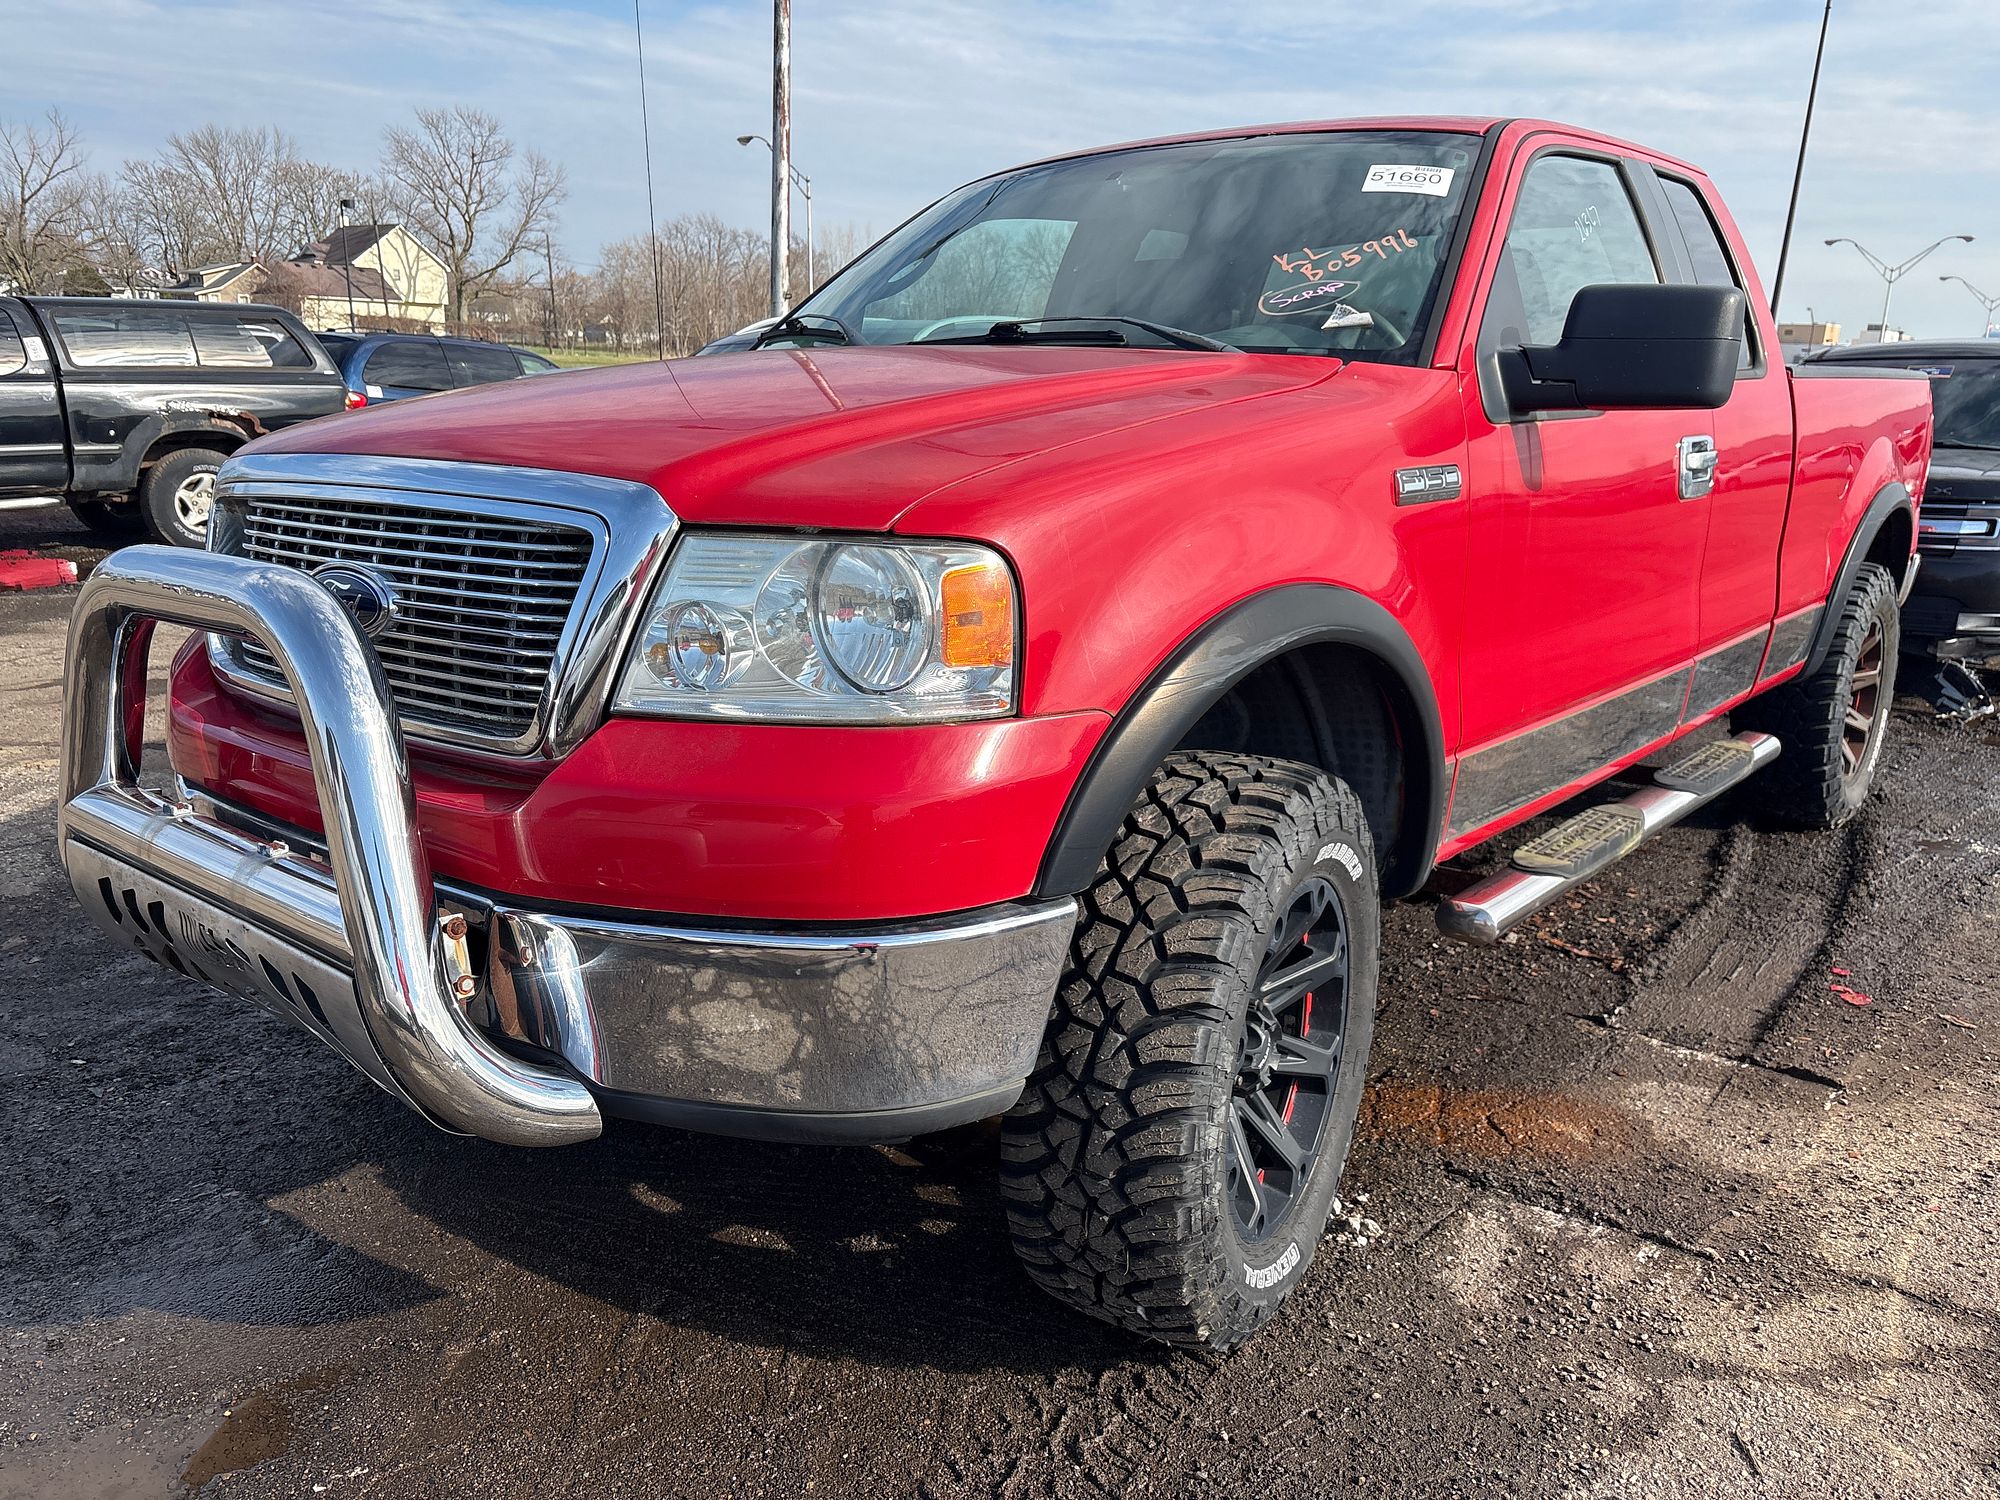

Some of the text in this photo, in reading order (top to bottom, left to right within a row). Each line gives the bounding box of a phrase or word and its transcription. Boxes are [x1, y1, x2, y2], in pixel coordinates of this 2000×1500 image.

[1371, 171, 1442, 184] 51660
[1300, 229, 1418, 281] B05996
[1269, 282, 1345, 308] SCRAP
[1313, 842, 1364, 882] GRABBER
[1243, 1241, 1301, 1289] GENERAL
